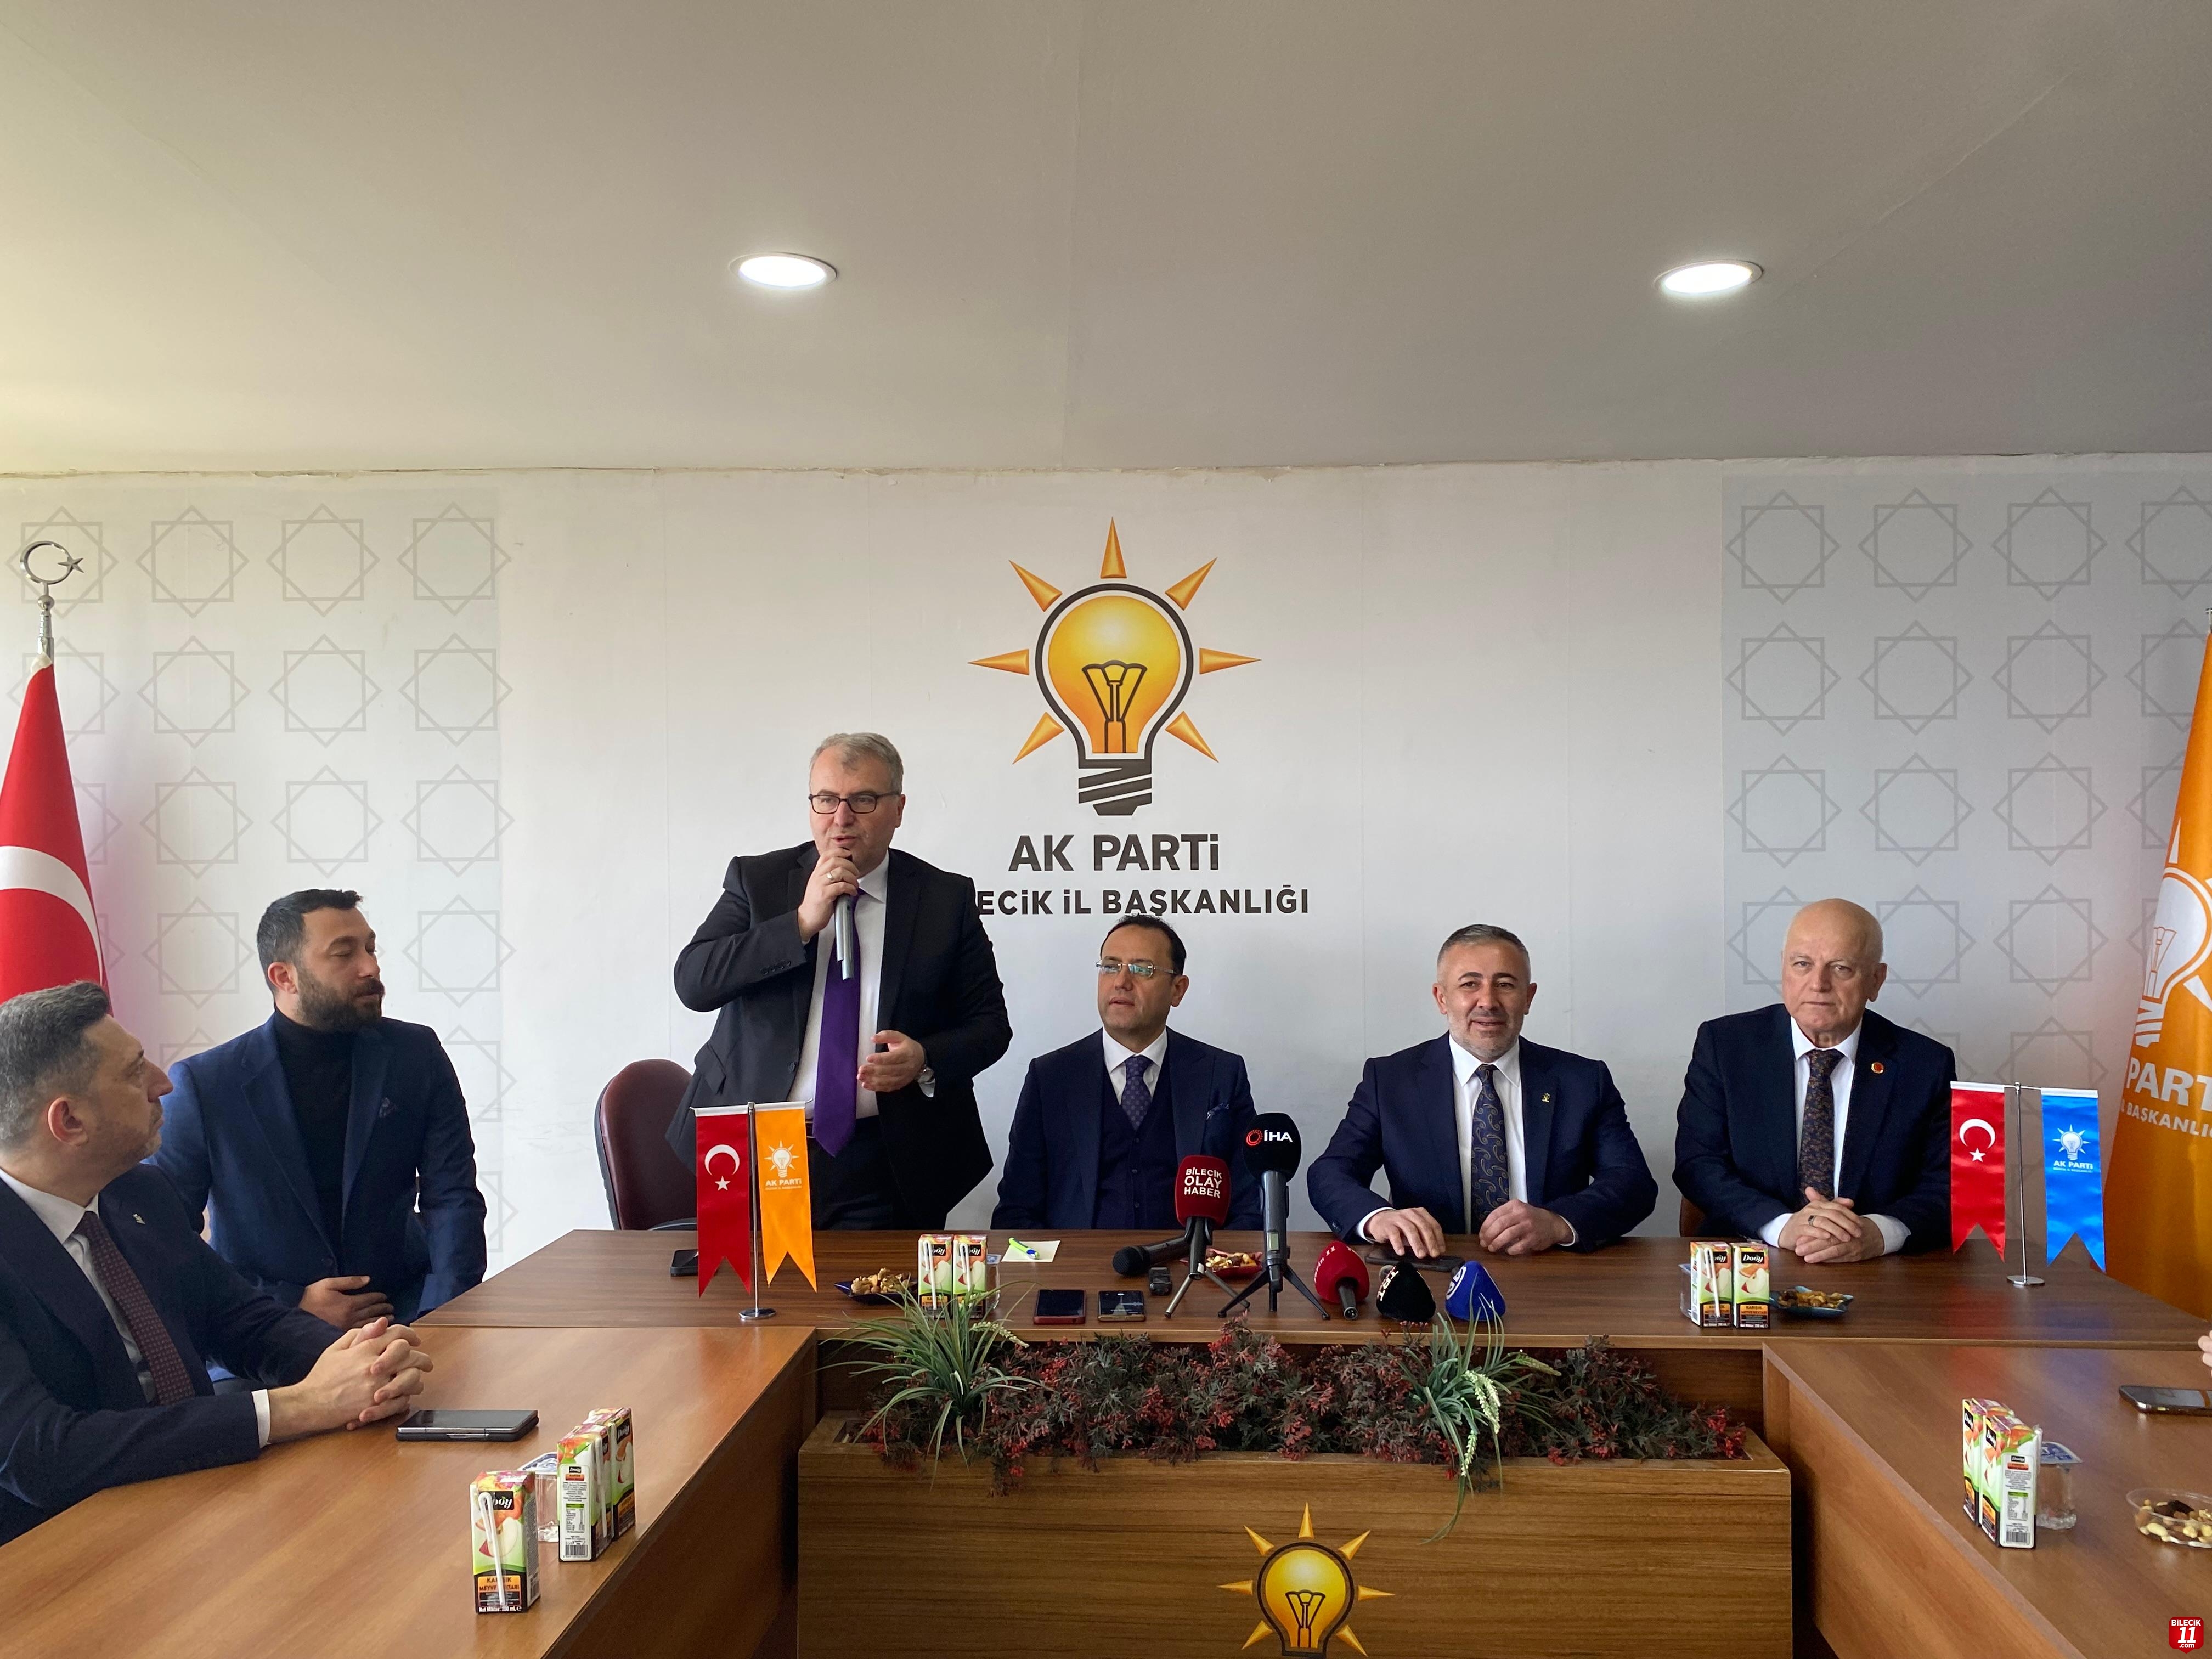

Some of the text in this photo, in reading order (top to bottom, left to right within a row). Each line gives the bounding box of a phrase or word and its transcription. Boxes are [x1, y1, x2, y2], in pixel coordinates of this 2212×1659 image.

[1008, 834, 1074, 871] AK
[1103, 884, 1308, 916] BAŞKANLIĞI
[2126, 1102, 2212, 1139] BAŞKANLI
[1184, 1176, 1222, 1189] OLAY
[1184, 1187, 1221, 1199] HABER
